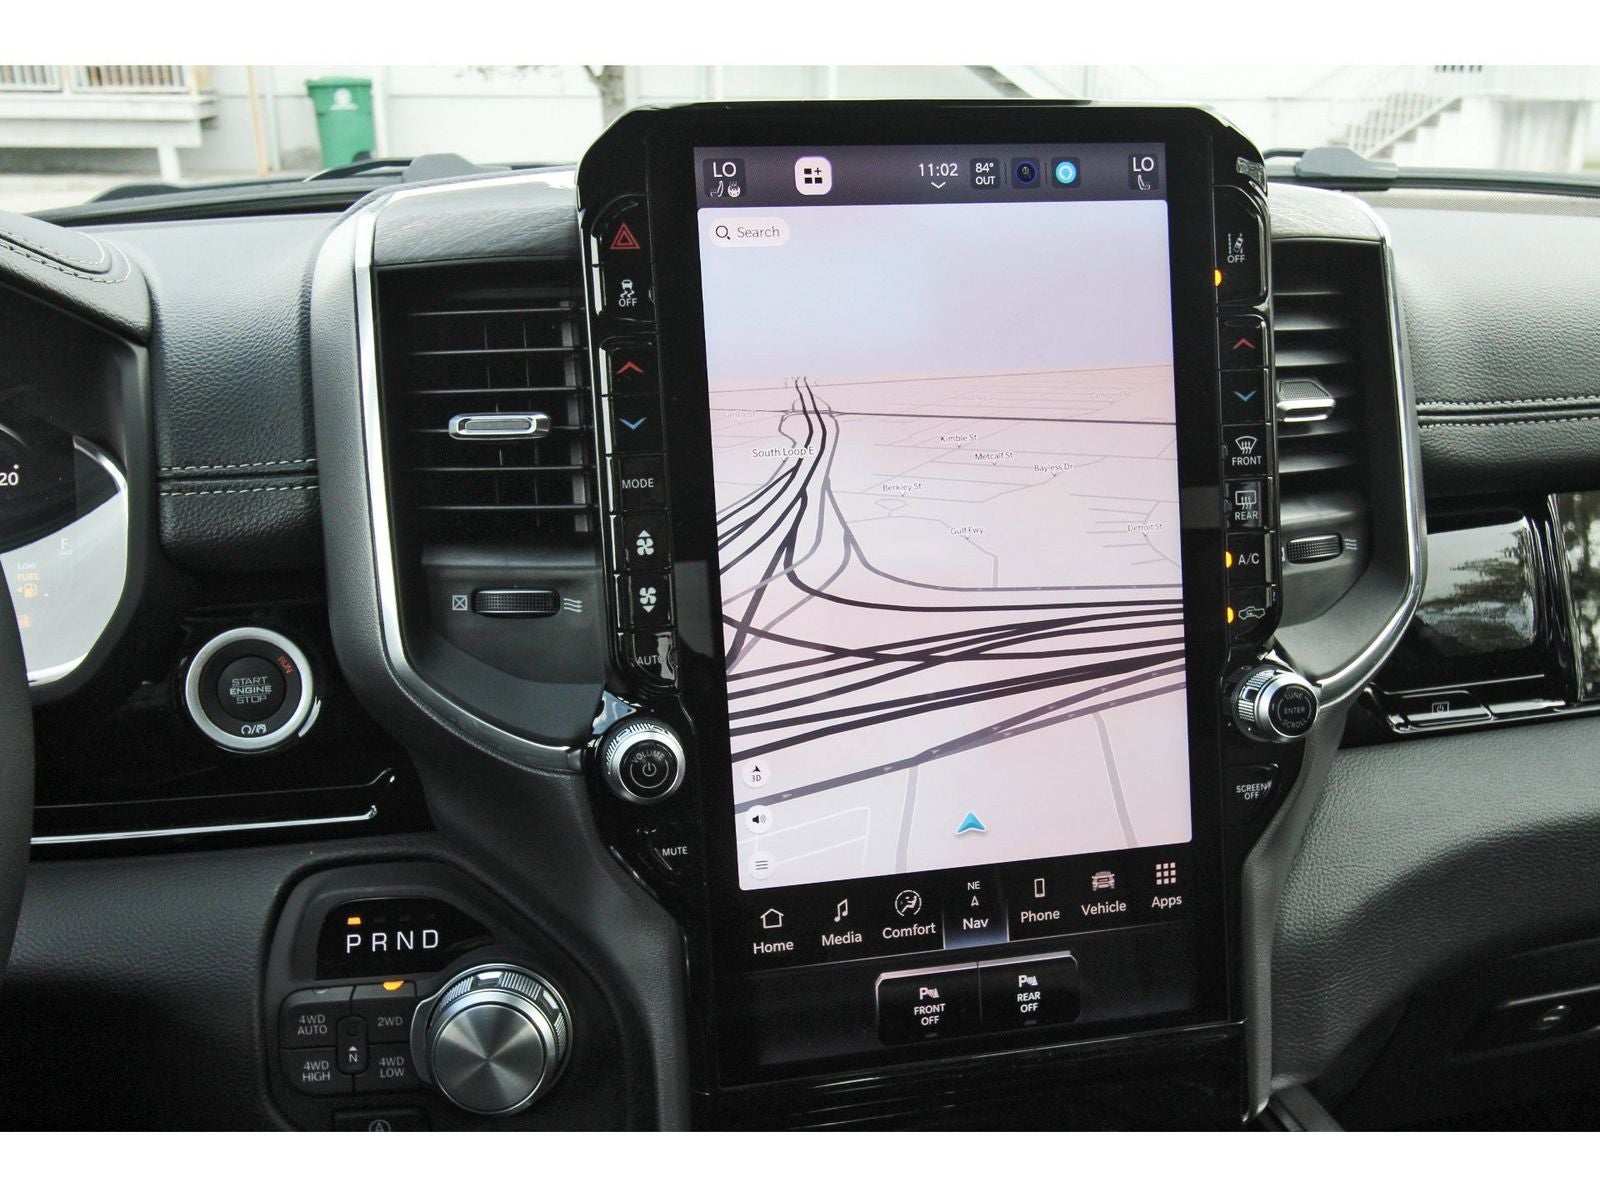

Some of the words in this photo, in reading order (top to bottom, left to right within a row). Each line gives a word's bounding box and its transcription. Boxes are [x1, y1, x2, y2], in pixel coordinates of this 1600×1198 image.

[712, 161, 737, 178] LO
[918, 163, 959, 177] 11:02
[1132, 156, 1154, 172] LO
[975, 176, 996, 185] OUT
[736, 225, 780, 240] Search
[1227, 254, 1245, 264] OFF
[618, 298, 638, 308] OFF
[940, 434, 968, 443] Kimble
[969, 434, 977, 442] St
[752, 448, 780, 458] South
[782, 448, 807, 460] Loop
[807, 447, 815, 456] E
[974, 452, 1004, 462] Metcalf
[1005, 451, 1013, 460] St
[1231, 455, 1262, 467] FRONT
[1034, 463, 1063, 474] Bayless
[1063, 463, 1073, 472] Dr
[621, 477, 655, 489] MODE
[882, 483, 910, 494] Berkley
[911, 482, 922, 491] St
[1234, 511, 1259, 521] REAR
[950, 526, 968, 536] Gulf
[968, 526, 984, 538] Fwy
[1127, 523, 1154, 533] Detroit
[1154, 523, 1163, 531] St
[1238, 552, 1260, 565] A/C
[16, 572, 41, 582] FUEL
[277, 655, 294, 674] RUN
[231, 675, 268, 688] START
[229, 685, 273, 696] ENGINE
[236, 694, 267, 705] STOP
[1284, 706, 1306, 715] ENTER
[631, 750, 665, 764] VOLUME
[750, 772, 762, 783] 3D
[1235, 782, 1268, 794] SCREEN
[1244, 791, 1260, 800] OFF
[661, 845, 688, 857] MUTE
[967, 880, 981, 891] NE
[752, 939, 794, 955] Home
[821, 930, 863, 947] Media
[881, 922, 937, 941] Comfort
[962, 917, 989, 931] Nav
[1019, 907, 1061, 924] Phone
[1081, 900, 1127, 916] Vehicle
[1151, 895, 1183, 911] Apps
[1016, 991, 1041, 1002] REAR
[913, 1003, 946, 1016] FRONT
[1020, 1002, 1039, 1013] OFF
[297, 1014, 326, 1025] 4WD
[377, 1015, 404, 1027] 2WD
[920, 1015, 940, 1026] OFF
[297, 1024, 328, 1036] AUTO
[348, 1053, 359, 1063] N
[378, 1056, 405, 1068] 4WD
[303, 1060, 330, 1072] 4WD
[379, 1066, 405, 1078] LOW
[302, 1070, 331, 1082] HIGH
